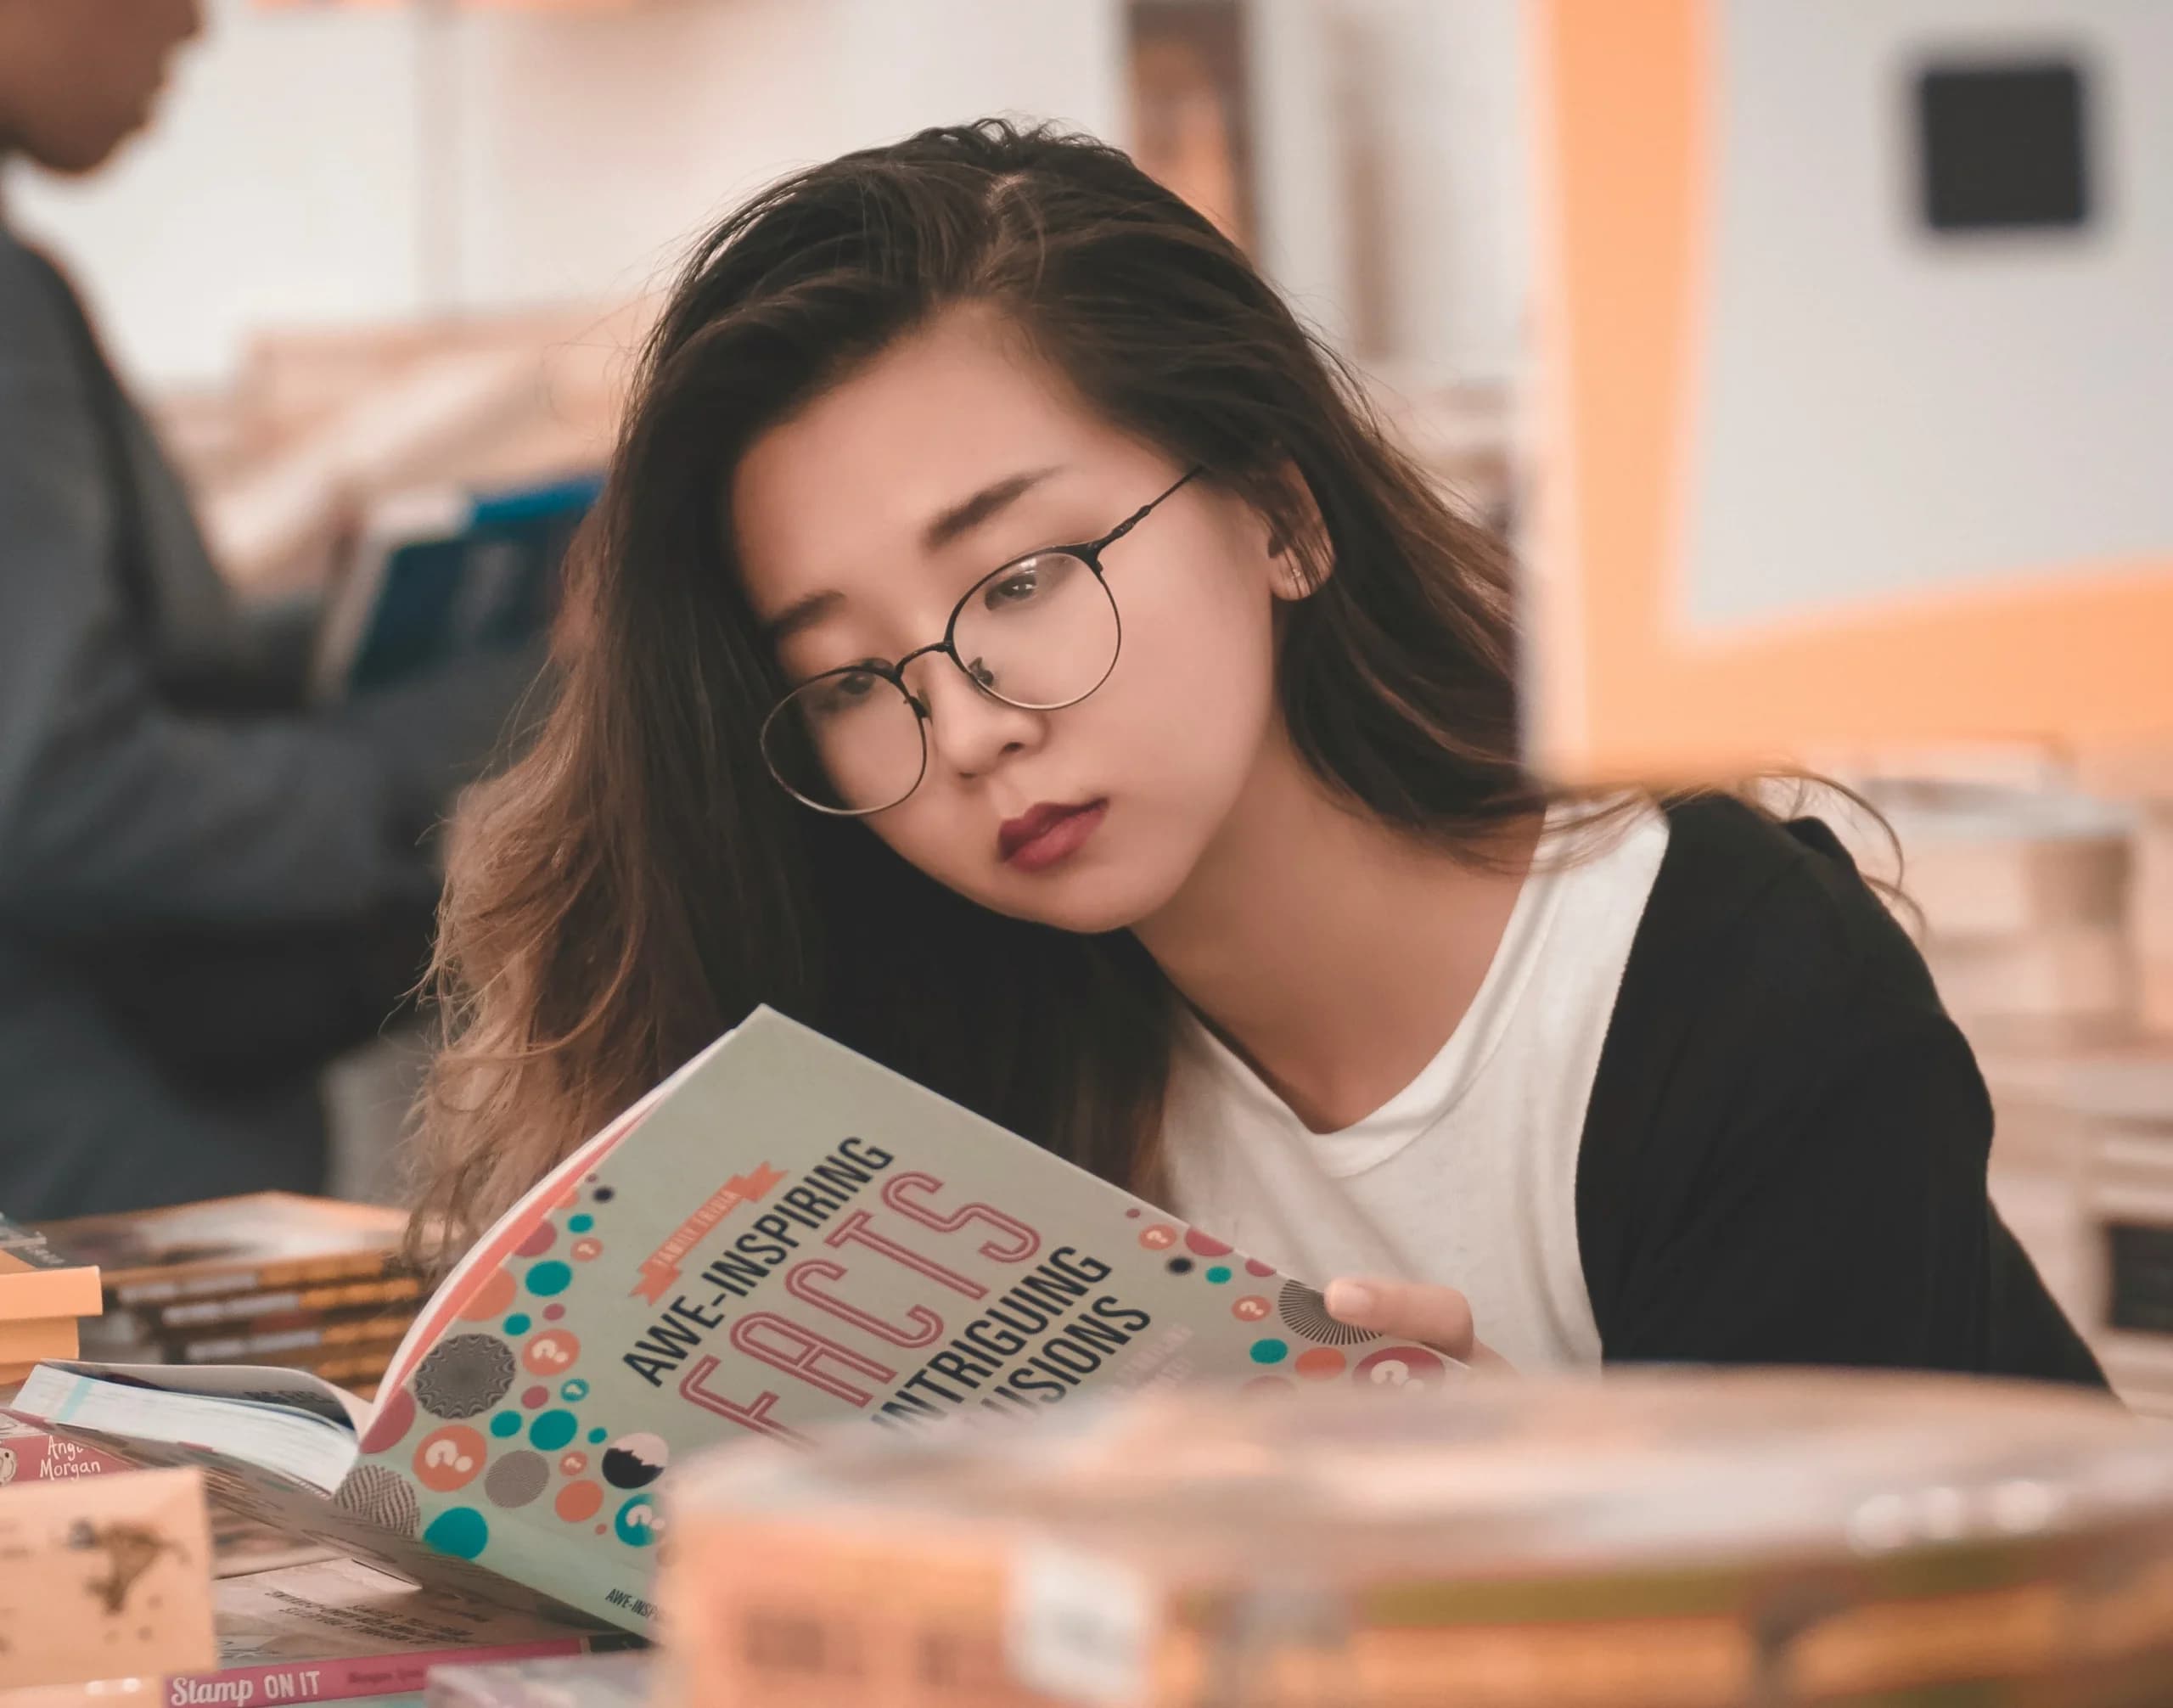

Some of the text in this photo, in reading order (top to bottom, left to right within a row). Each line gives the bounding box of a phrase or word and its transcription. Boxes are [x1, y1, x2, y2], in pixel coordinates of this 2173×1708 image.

[622, 1137, 895, 1387] AWE-INSPIRING
[679, 1171, 1041, 1447] FACTS
[980, 1295, 1152, 1417] USIONS
[40, 1458, 101, 1481] Morgan
[171, 1677, 253, 1706] Stamp
[263, 1674, 295, 1699] ON
[300, 1671, 320, 1696] IT
